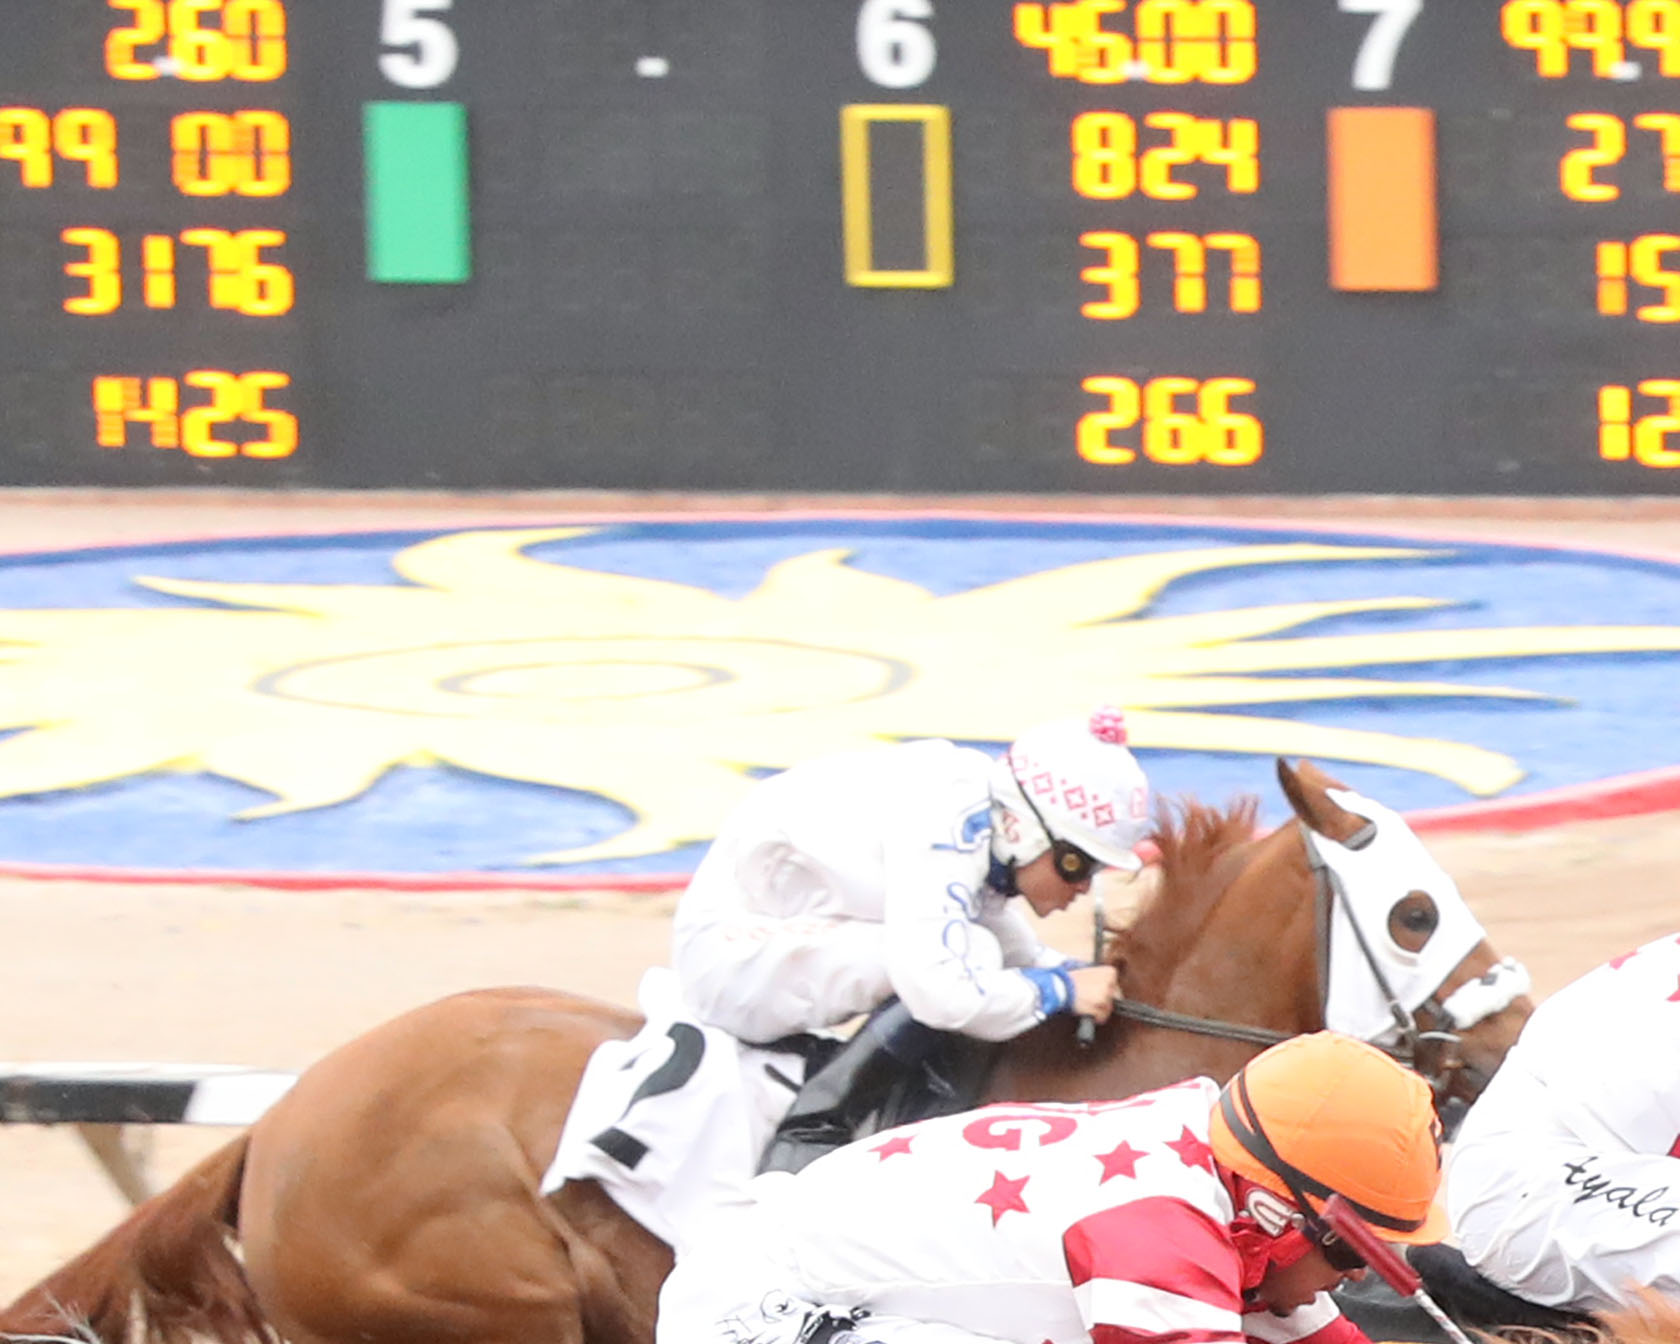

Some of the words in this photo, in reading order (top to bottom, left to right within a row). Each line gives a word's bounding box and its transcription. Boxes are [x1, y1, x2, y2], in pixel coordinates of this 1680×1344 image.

[378, 0, 458, 88] 5
[856, 0, 937, 88] 6
[1337, 0, 1424, 91] 7
[1070, 109, 1260, 200] 824
[61, 226, 294, 317] 3176
[1079, 230, 1262, 320] 377
[92, 368, 298, 459] 1425
[1075, 375, 1264, 466] 266
